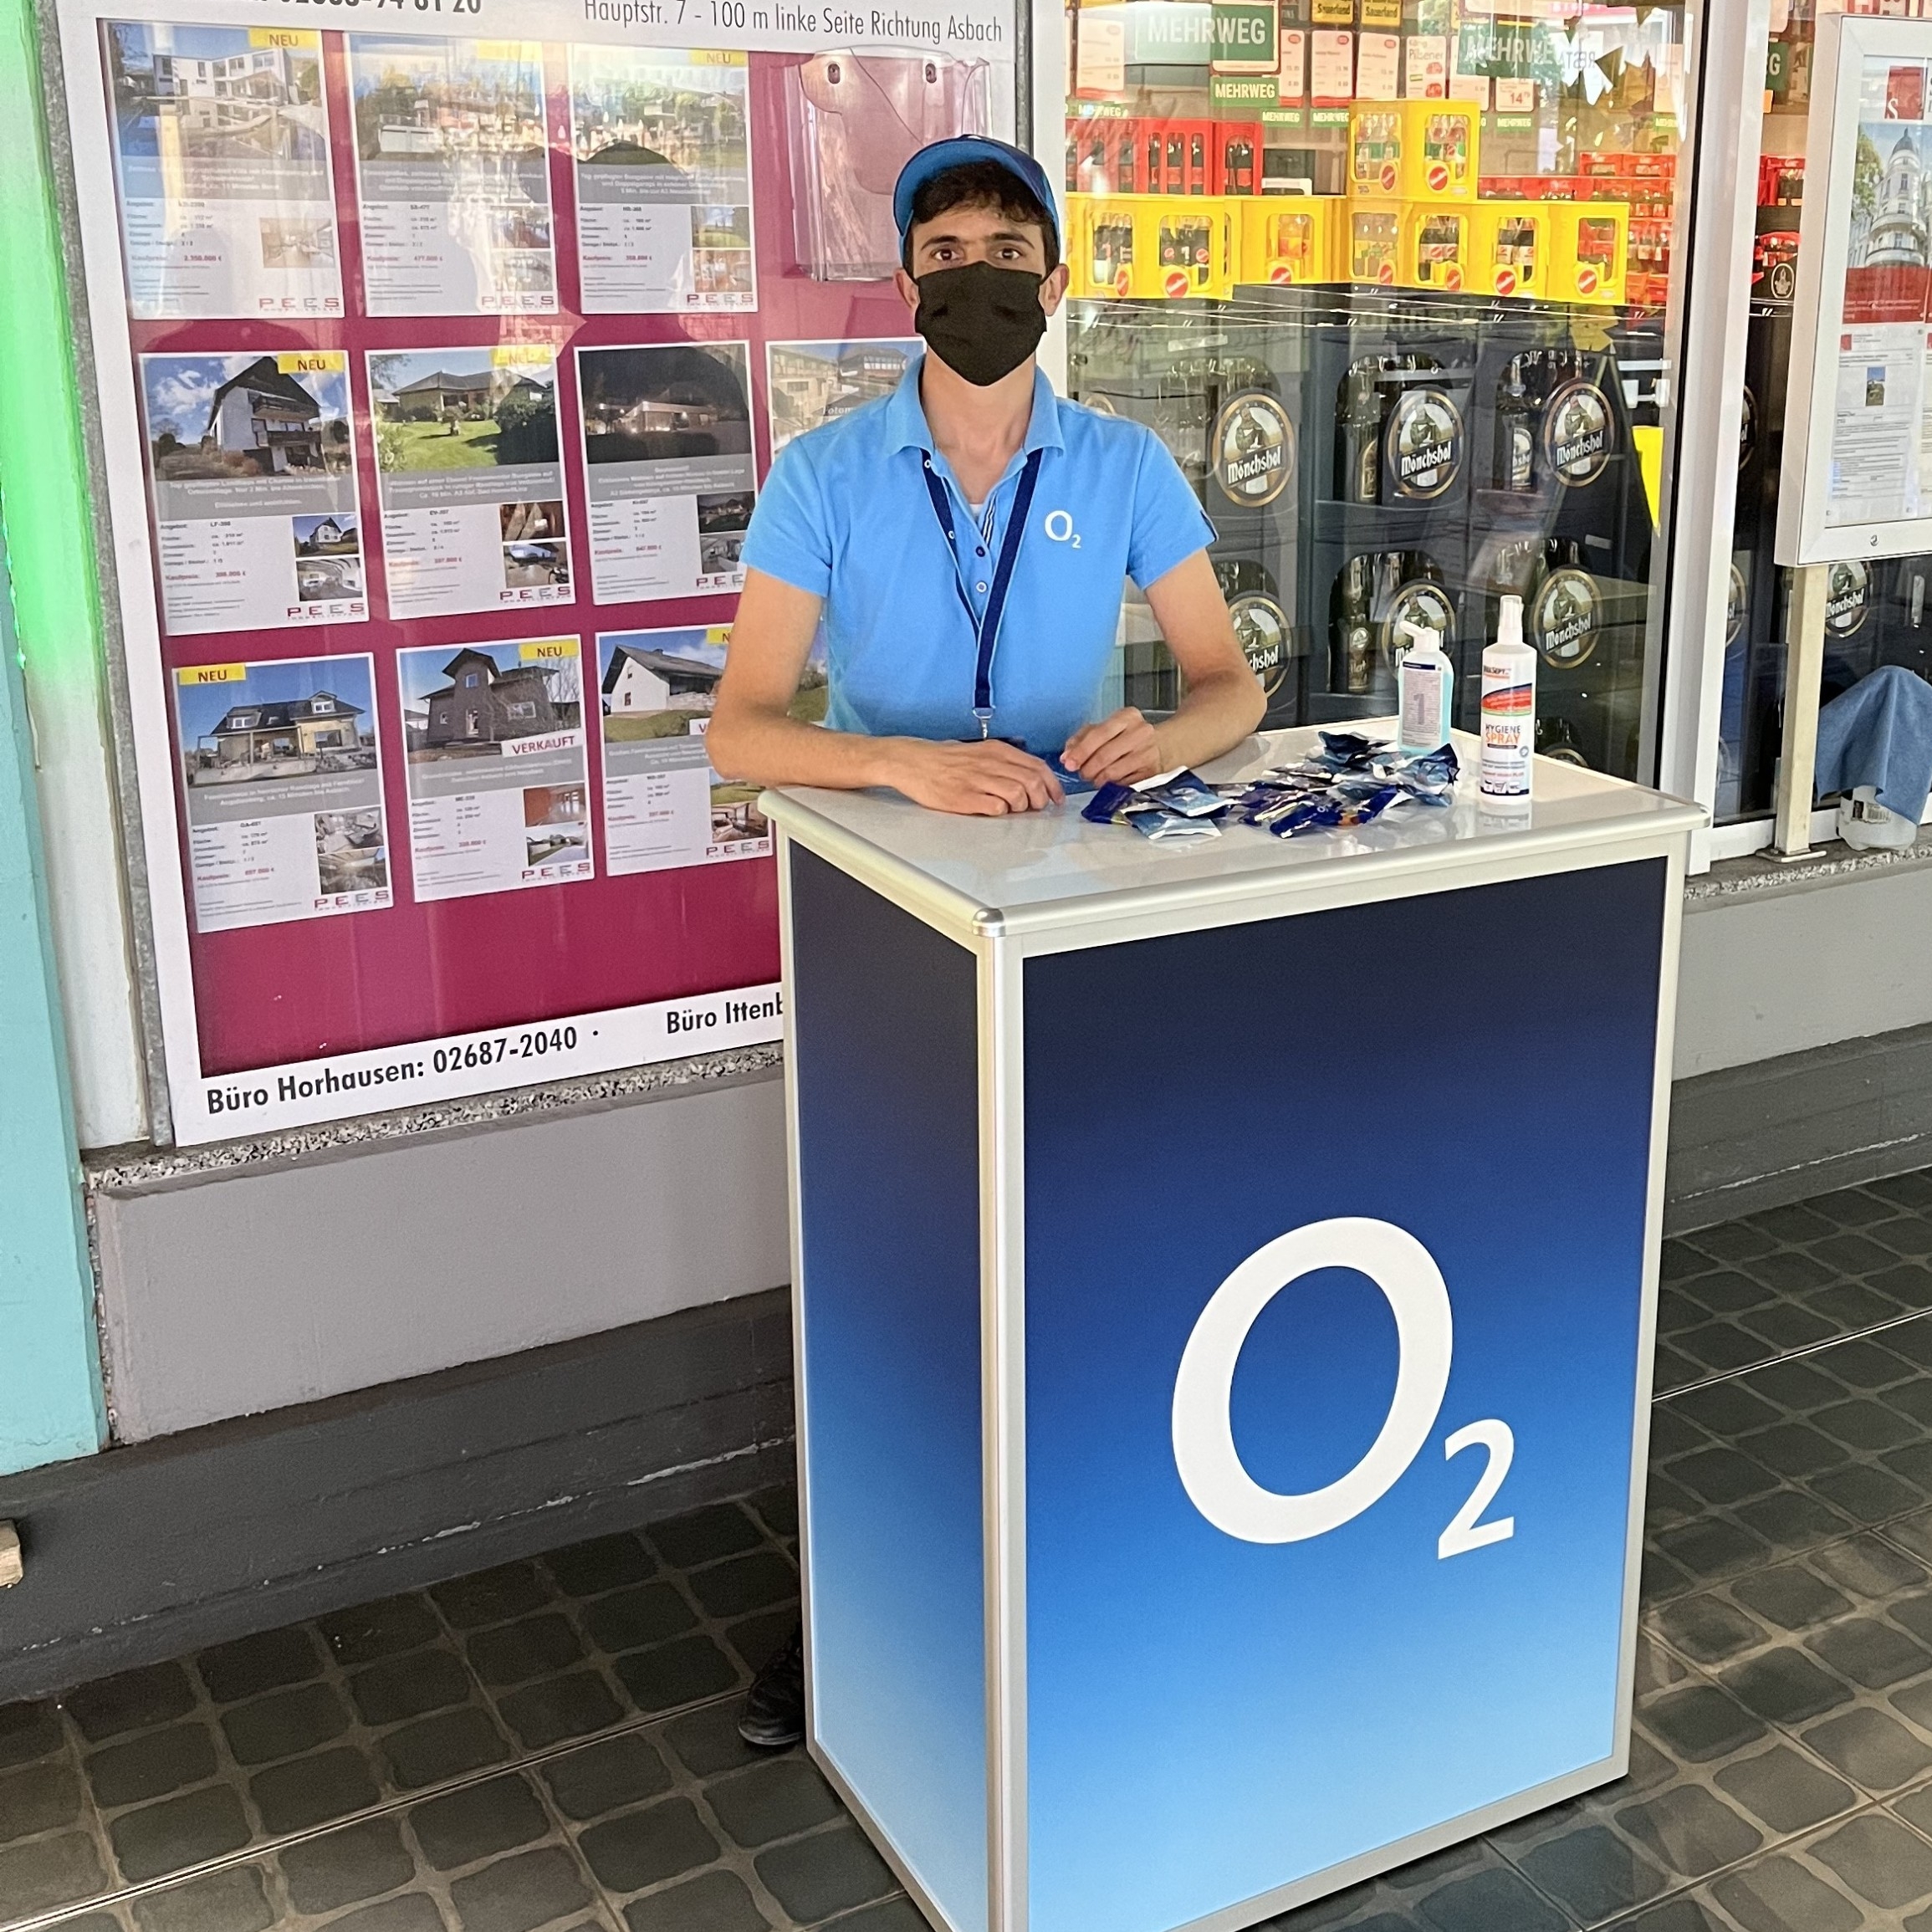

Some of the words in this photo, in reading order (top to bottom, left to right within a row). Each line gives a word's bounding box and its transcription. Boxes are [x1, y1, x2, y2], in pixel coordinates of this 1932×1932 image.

[585, 0, 668, 28] Hauptstr.
[676, 0, 686, 25] 7
[710, 1, 745, 28] 100
[753, 11, 768, 29] m
[775, 3, 816, 33] linke
[823, 8, 864, 35] Seite
[871, 10, 941, 45] Richtung
[947, 14, 1002, 42] Asbach
[1147, 15, 1266, 45] MEHRWEG
[269, 34, 299, 47] NEU
[706, 53, 731, 64] NEU
[1214, 83, 1275, 99] MEHRWEG
[259, 298, 340, 309] PEES
[482, 295, 555, 307] PEES
[687, 294, 754, 304] PEES
[297, 359, 326, 371] NEU
[1228, 445, 1283, 485] Mönchshof
[1401, 441, 1452, 477] Mönchshof
[696, 574, 744, 587] PEE
[499, 586, 571, 601] PEES
[287, 602, 365, 617] PEES
[537, 647, 563, 657] NEU
[197, 669, 227, 682] NEU
[1485, 723, 1521, 734] HYGIENE
[511, 735, 575, 755] VERKAUFT
[1485, 732, 1521, 744] SPRAY
[706, 841, 770, 856] PEES
[522, 862, 590, 879] PEES
[314, 891, 390, 909] PEES
[667, 1007, 717, 1035] Büro
[207, 1086, 268, 1114] Büro
[278, 1061, 424, 1101] Horhausen:
[432, 1025, 577, 1074] 02687-2040
[1172, 1216, 1515, 1561] O2
